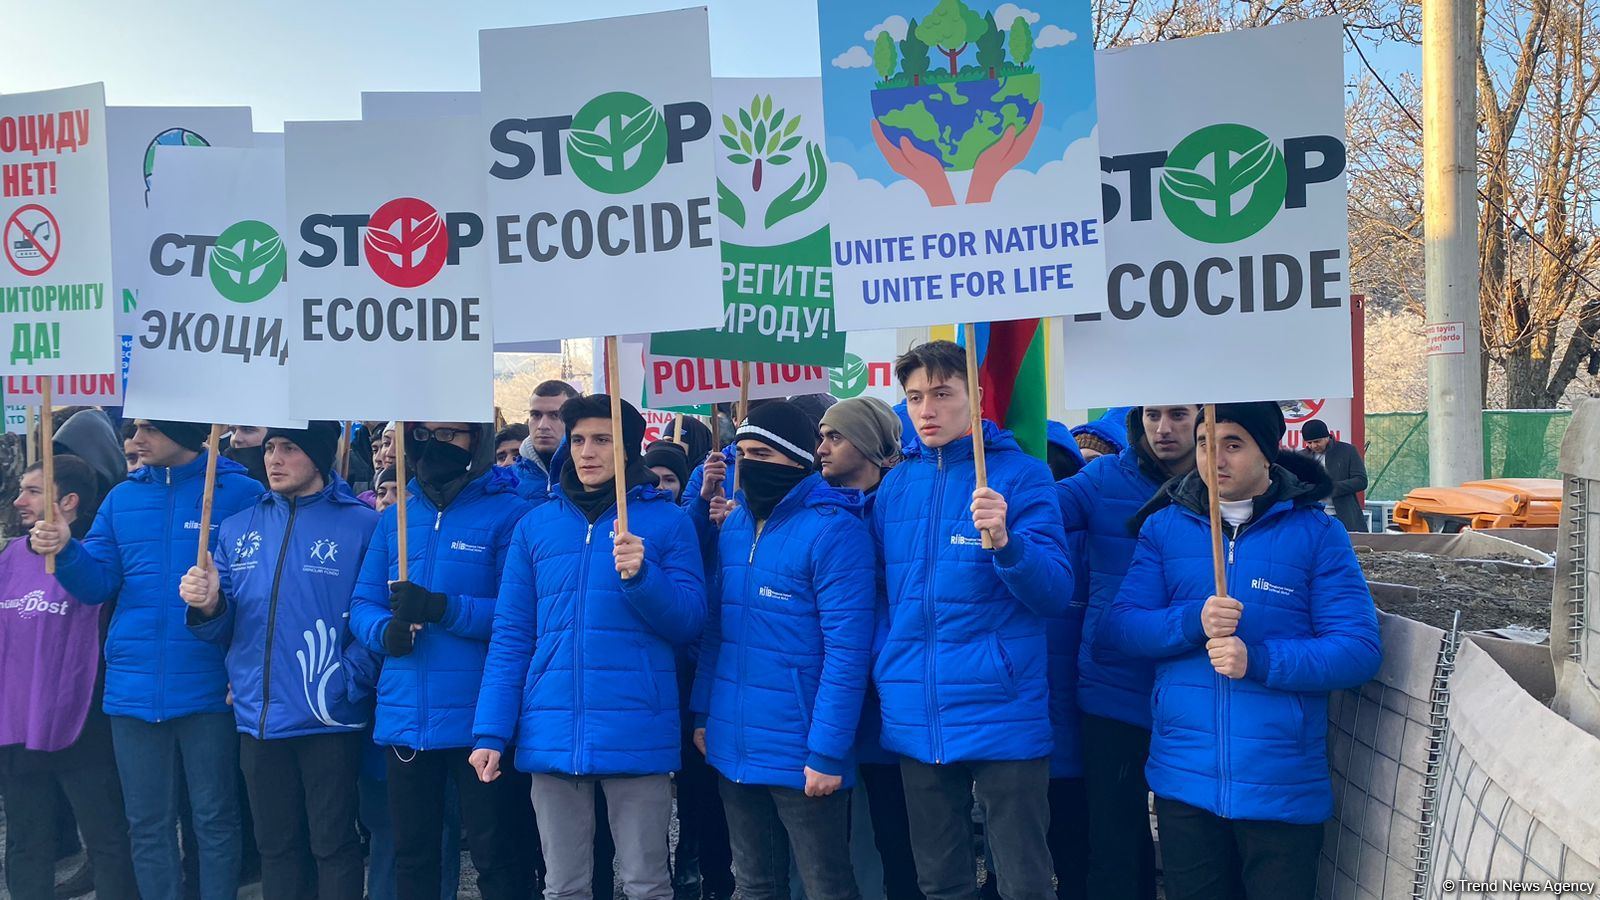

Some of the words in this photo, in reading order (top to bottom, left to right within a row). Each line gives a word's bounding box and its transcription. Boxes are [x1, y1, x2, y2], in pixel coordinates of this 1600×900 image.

[489, 91, 712, 194] STOP
[3, 161, 57, 197] НЕТ!
[298, 197, 484, 288] STOP
[496, 197, 713, 264] ECOCIDE
[834, 236, 915, 266] UNITE
[922, 231, 977, 260] FOR
[985, 218, 1099, 254] NATURE
[150, 220, 288, 303] СТО
[862, 274, 943, 305] UNITE
[950, 270, 1006, 298] FOR
[1013, 263, 1074, 293] LIFE
[1074, 249, 1341, 322] COCIDE
[302, 297, 480, 341] ECOCIDE
[10, 322, 61, 365] ДА!
[24, 598, 68, 615] Dost
